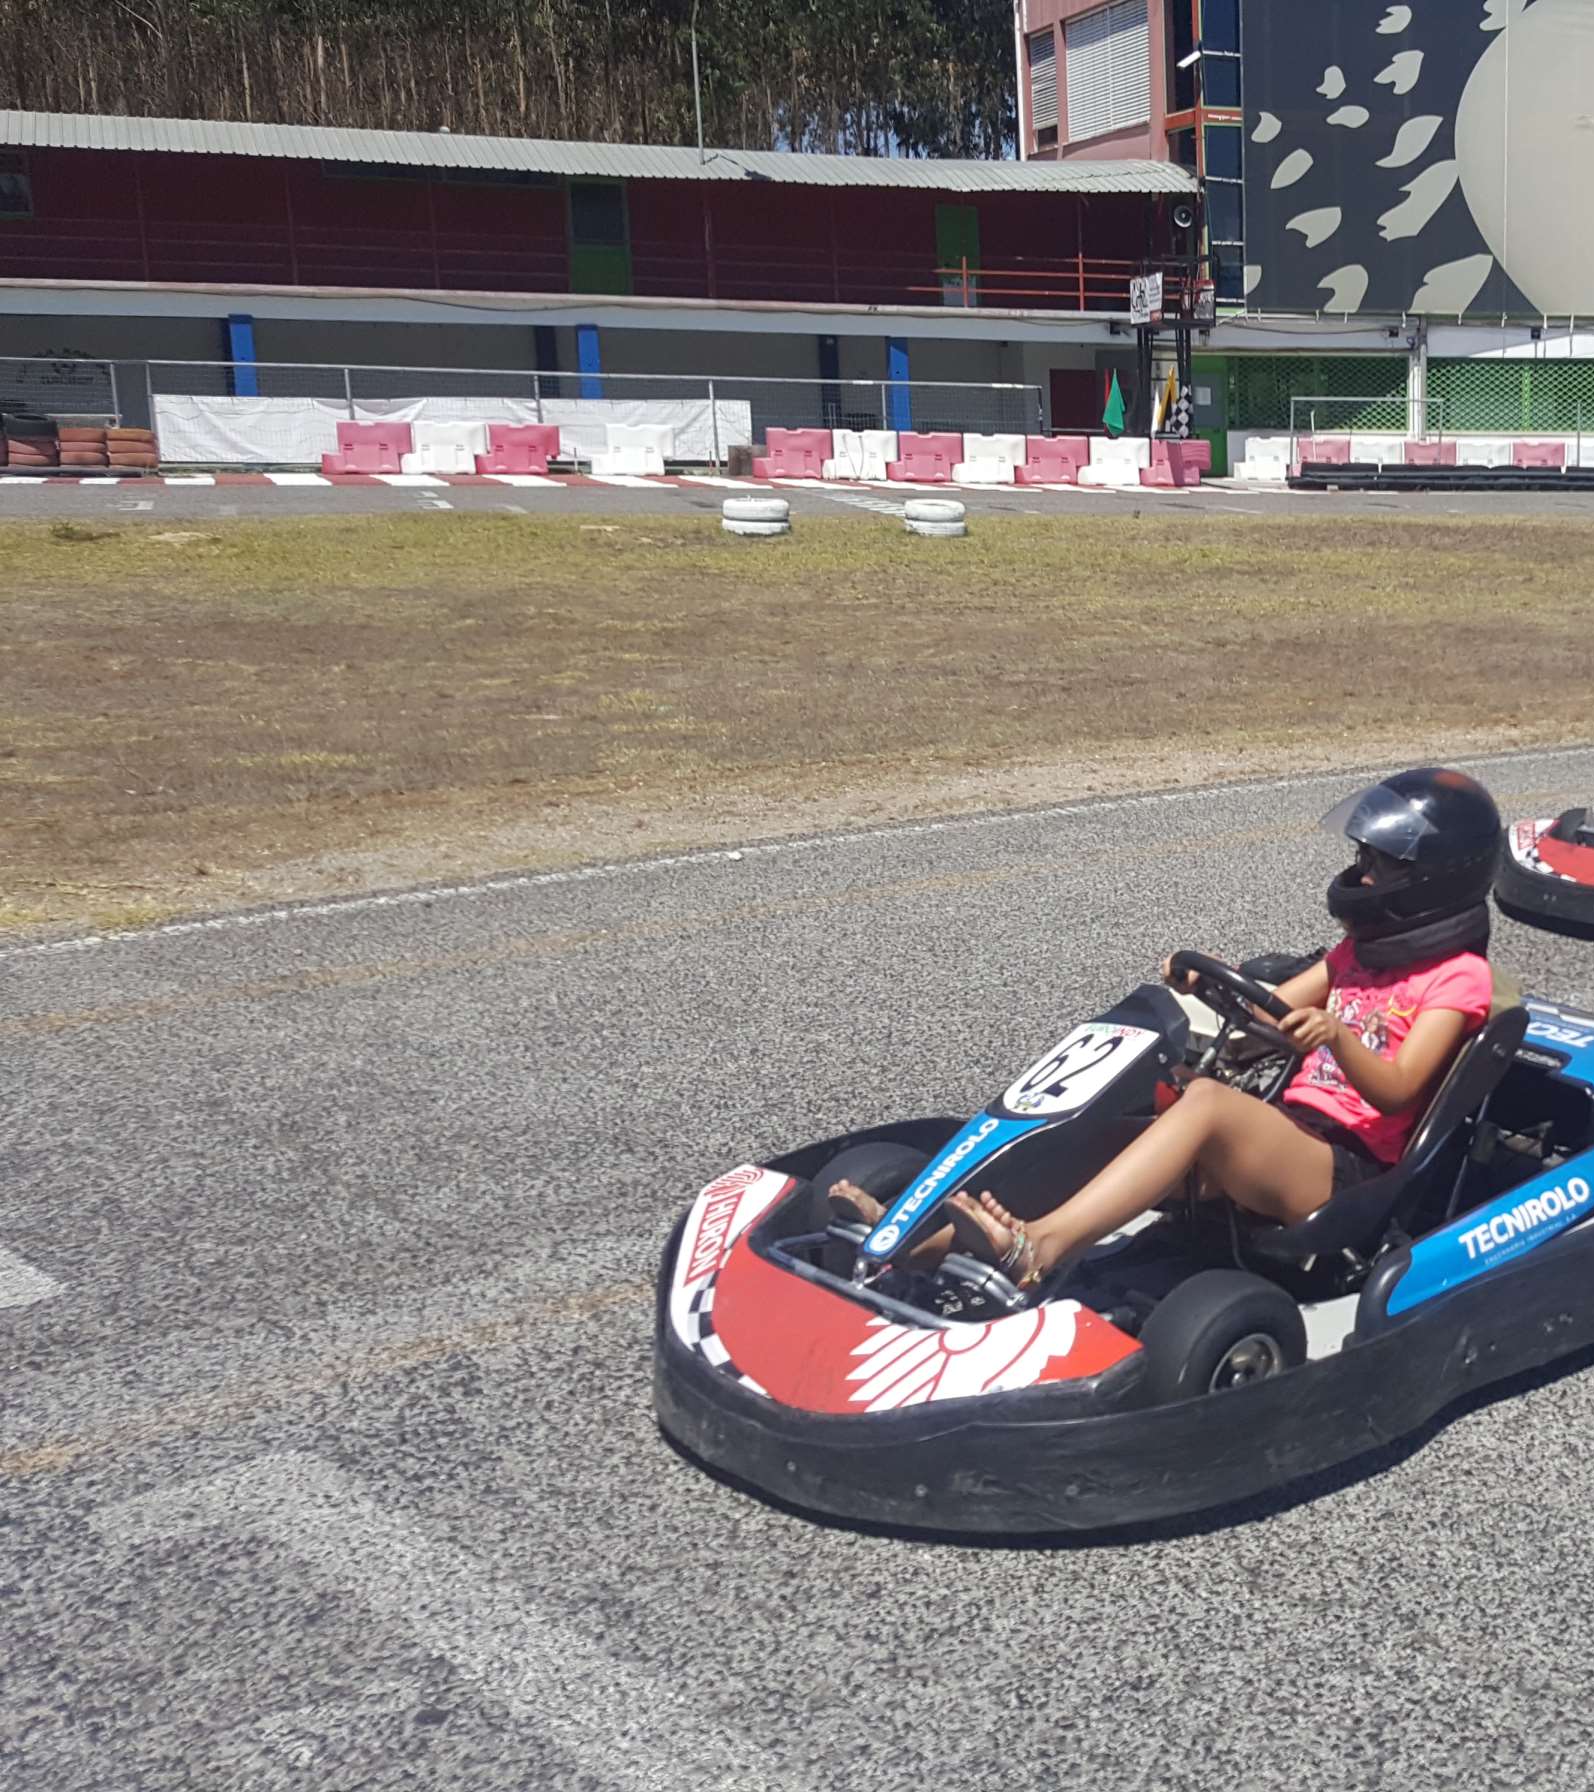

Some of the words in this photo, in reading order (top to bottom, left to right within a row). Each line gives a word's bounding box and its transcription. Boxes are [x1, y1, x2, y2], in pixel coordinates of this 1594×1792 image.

[1020, 1033, 1124, 1098] 62
[891, 1118, 1000, 1223] TECNIROLO
[687, 1197, 739, 1280] HURON
[1458, 1177, 1590, 1260] TECNIROLO
